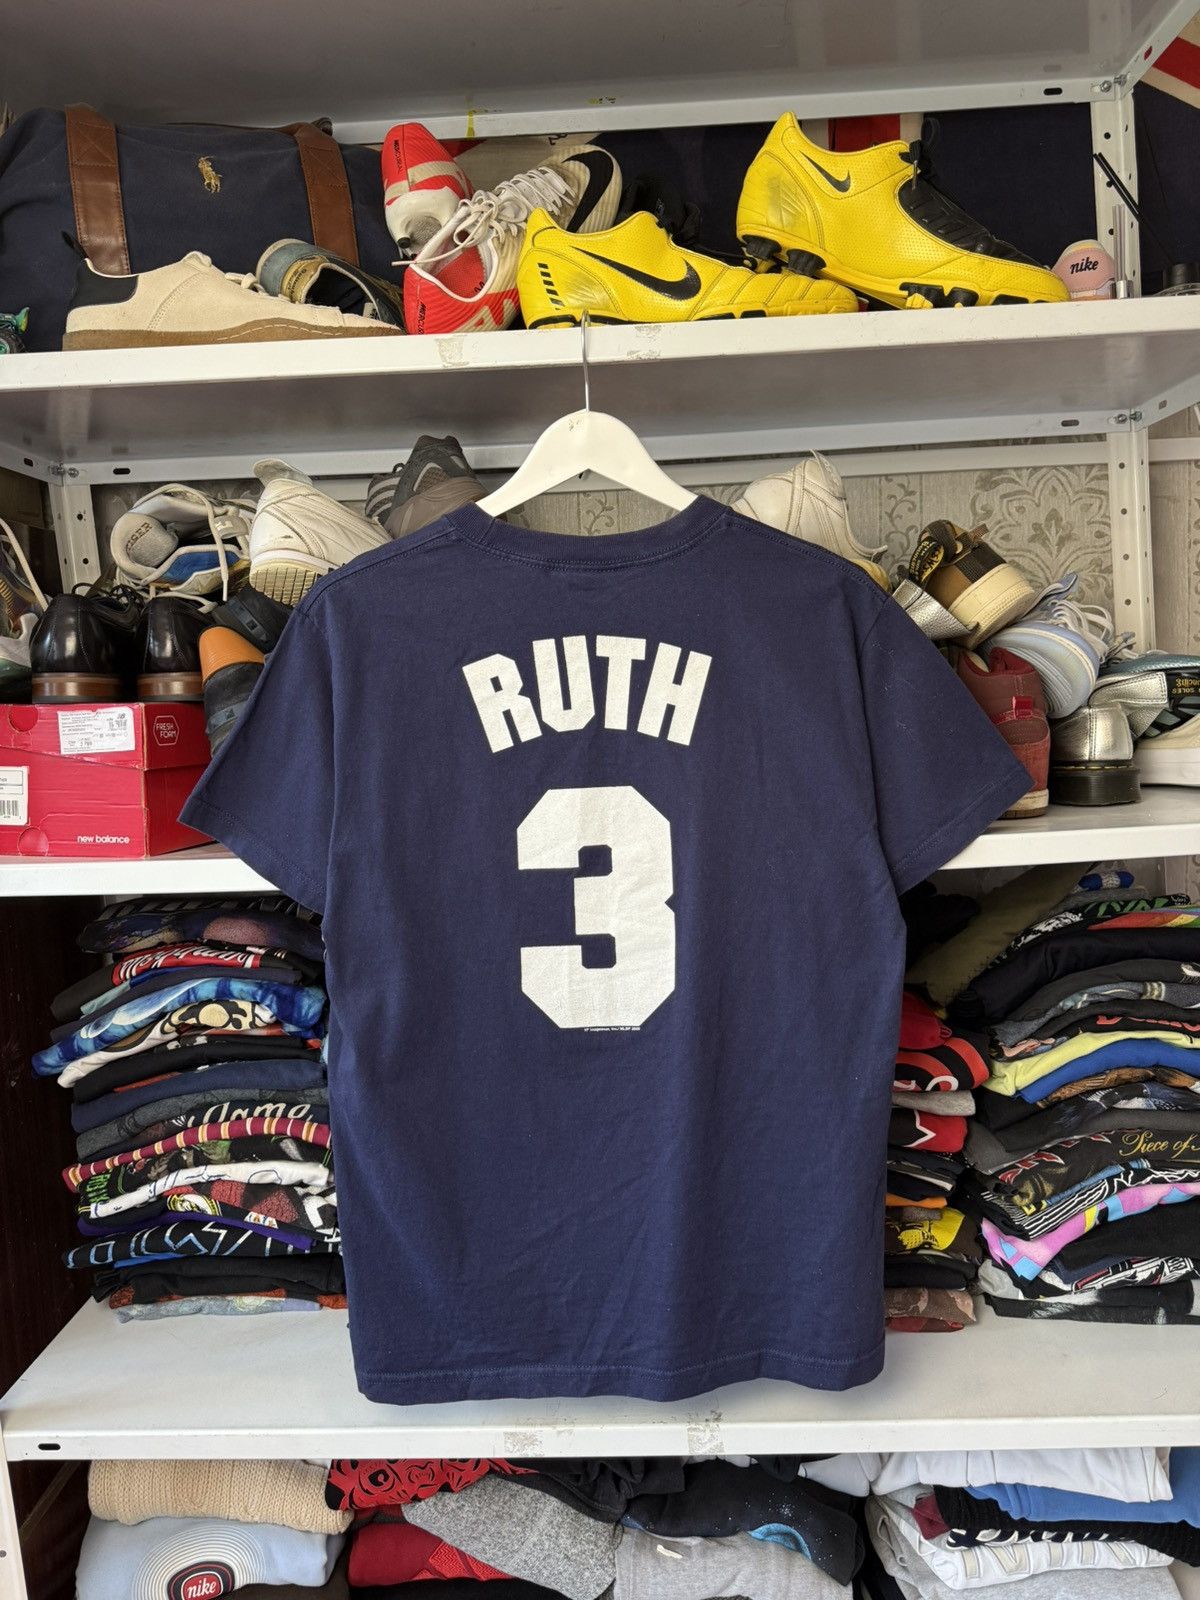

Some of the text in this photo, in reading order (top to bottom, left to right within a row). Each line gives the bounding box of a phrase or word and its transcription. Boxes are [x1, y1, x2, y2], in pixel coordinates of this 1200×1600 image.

[1070, 257, 1099, 274] nike
[462, 634, 712, 754] RUTH
[95, 834, 130, 844] balance
[516, 785, 676, 1029] 3
[1171, 1133, 1198, 1159] of
[187, 1578, 216, 1599] nike
